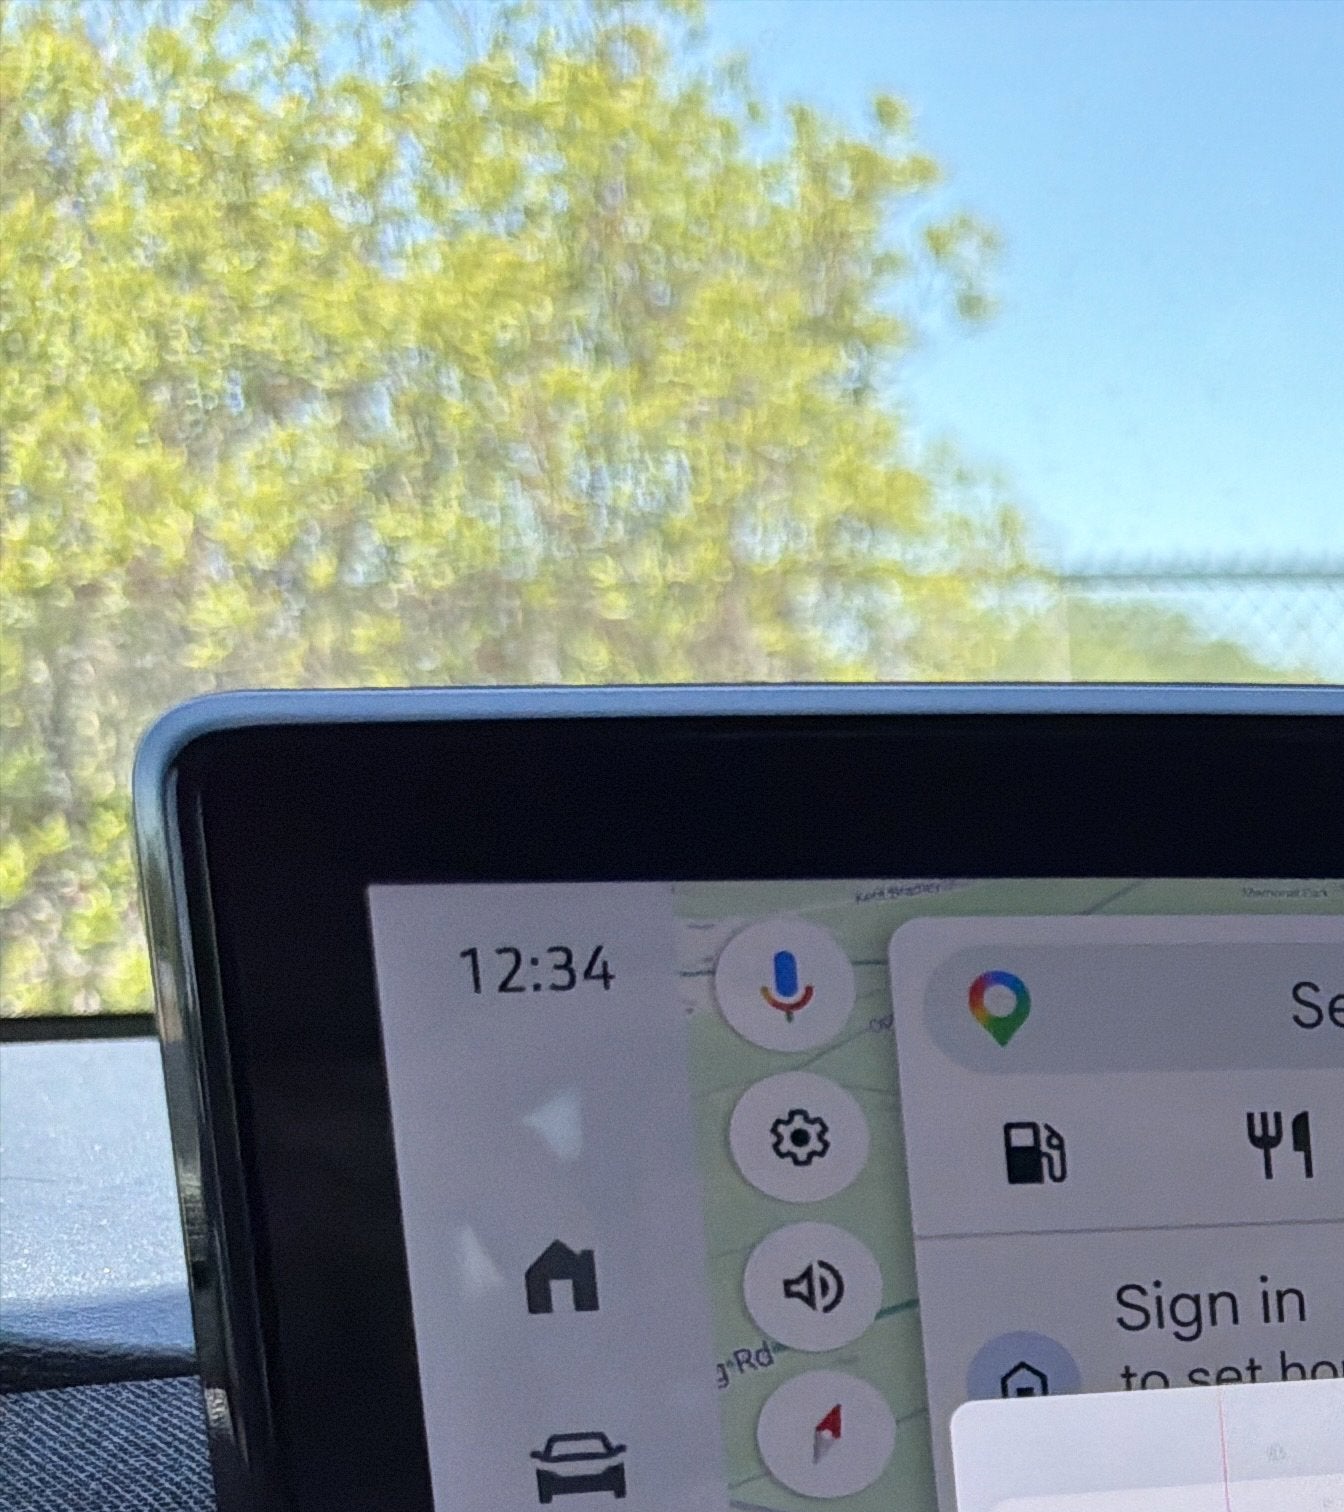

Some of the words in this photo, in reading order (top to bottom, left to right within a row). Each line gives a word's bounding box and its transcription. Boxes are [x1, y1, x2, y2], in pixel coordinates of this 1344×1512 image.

[460, 946, 615, 993] 12:34
[1116, 1280, 1239, 1342] Sign
[1260, 1275, 1306, 1323] in
[733, 1340, 775, 1374] Rd
[1121, 1365, 1170, 1391] to
[1188, 1358, 1262, 1386] set
